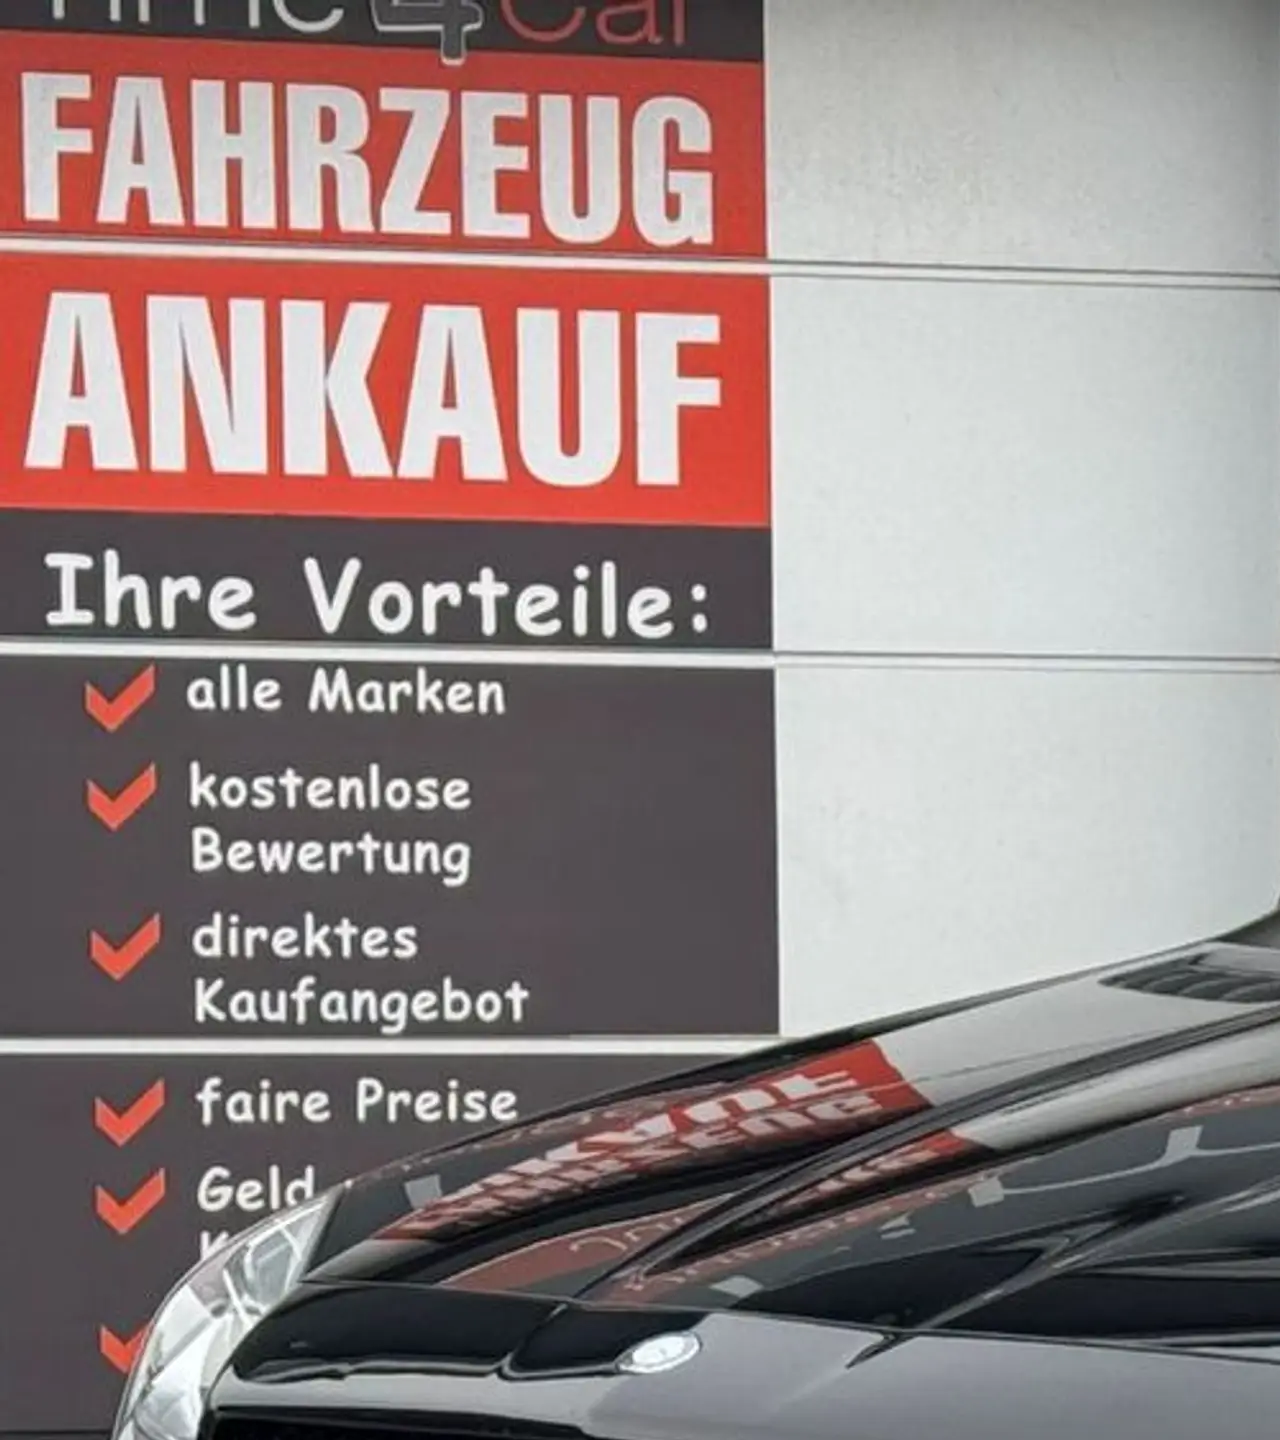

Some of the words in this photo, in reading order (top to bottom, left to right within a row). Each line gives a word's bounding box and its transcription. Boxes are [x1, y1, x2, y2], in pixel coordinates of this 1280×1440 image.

[21, 72, 714, 247] FAHRZEUG
[24, 291, 722, 487] ANKAUF
[44, 549, 258, 632] Ihre
[303, 556, 710, 640] Vorteile:
[186, 663, 284, 711] alle
[308, 667, 506, 716] Marken
[190, 761, 472, 811] kostenlose
[192, 826, 471, 888] Bewertung
[192, 911, 419, 960] direktes
[195, 975, 530, 1036] Kaufangebot
[195, 1076, 332, 1127] faire
[356, 1077, 519, 1124] Preise
[197, 1163, 316, 1212] Geld
